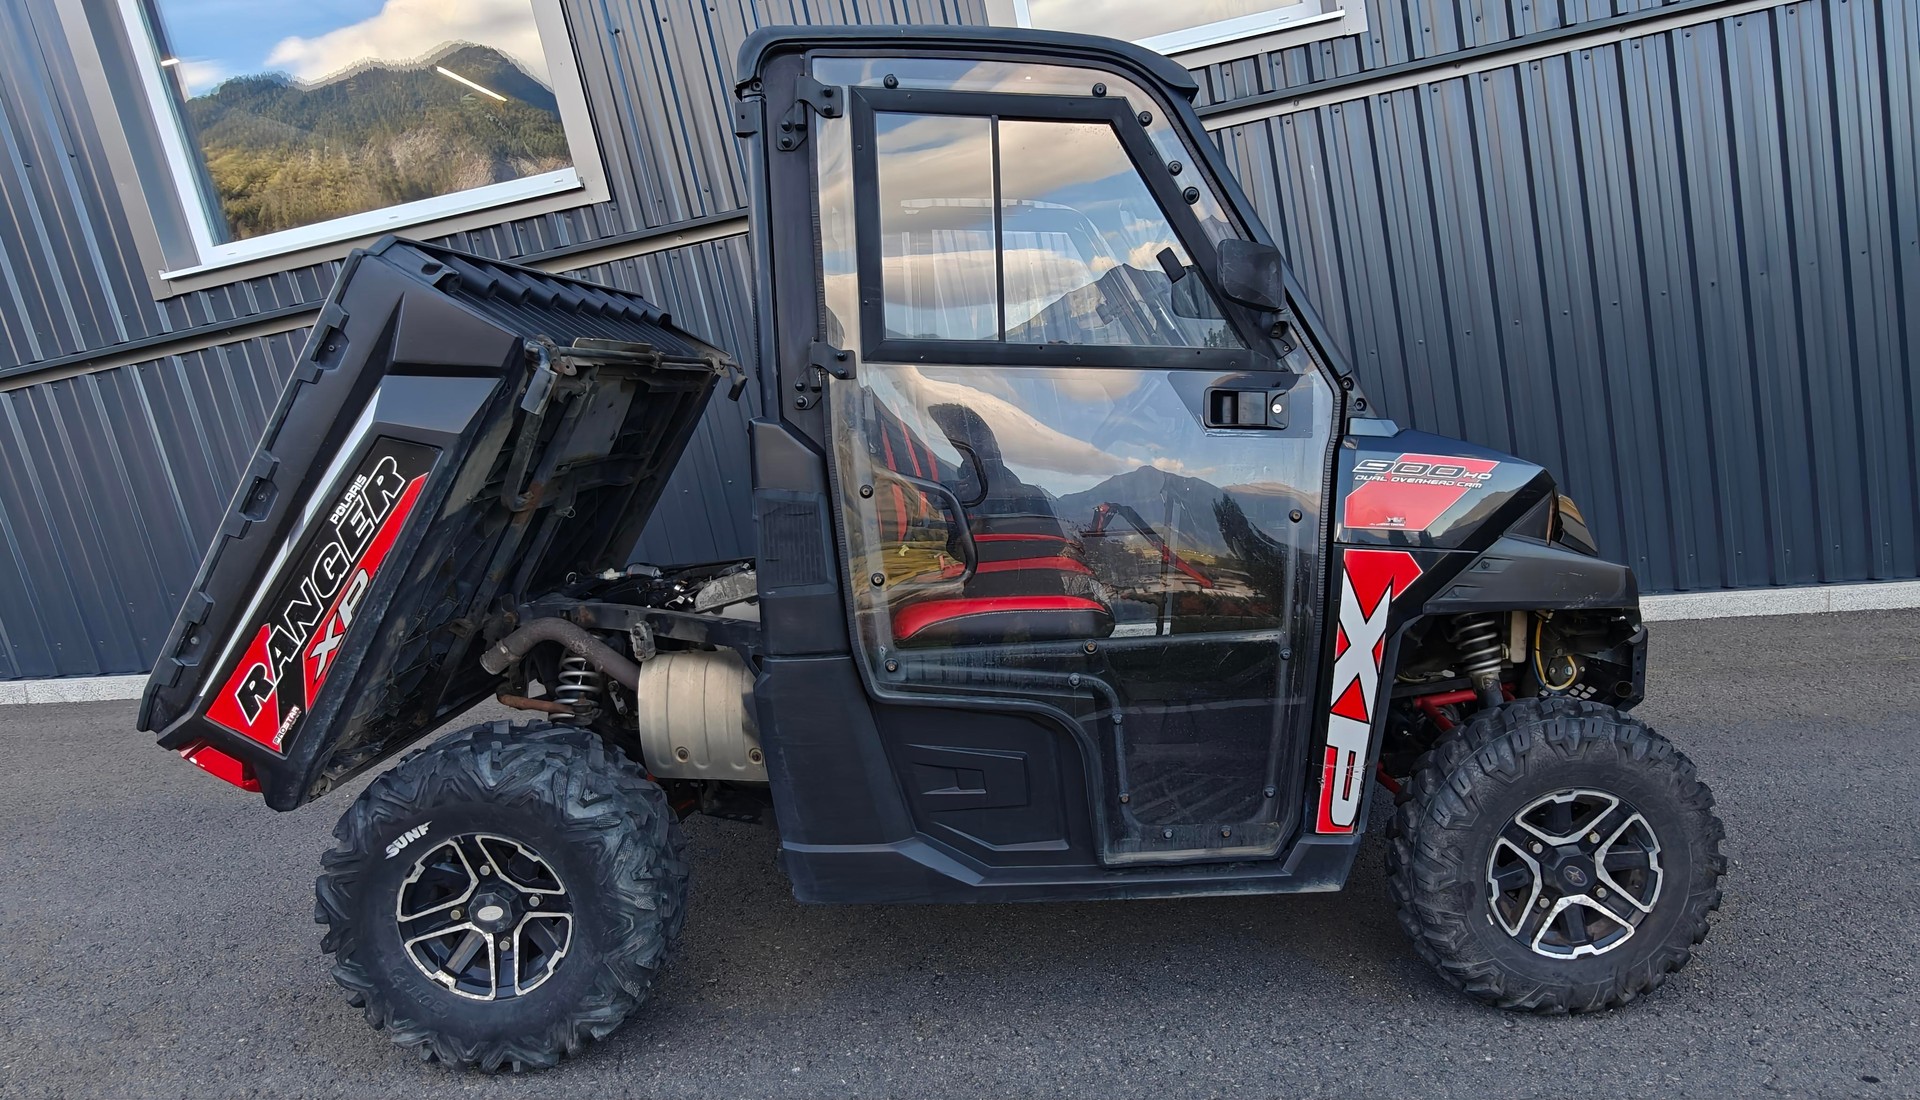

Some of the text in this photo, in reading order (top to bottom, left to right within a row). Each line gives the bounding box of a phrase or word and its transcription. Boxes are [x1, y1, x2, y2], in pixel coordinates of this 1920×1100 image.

[330, 474, 367, 525] POLARIS
[1354, 474, 1482, 490] DUAL OVERHEAD CAM
[234, 455, 406, 726] RANGER
[308, 568, 370, 680] XP
[1327, 567, 1392, 828] XP
[272, 705, 300, 745] PROSTAR
[385, 820, 432, 860] SUNF
